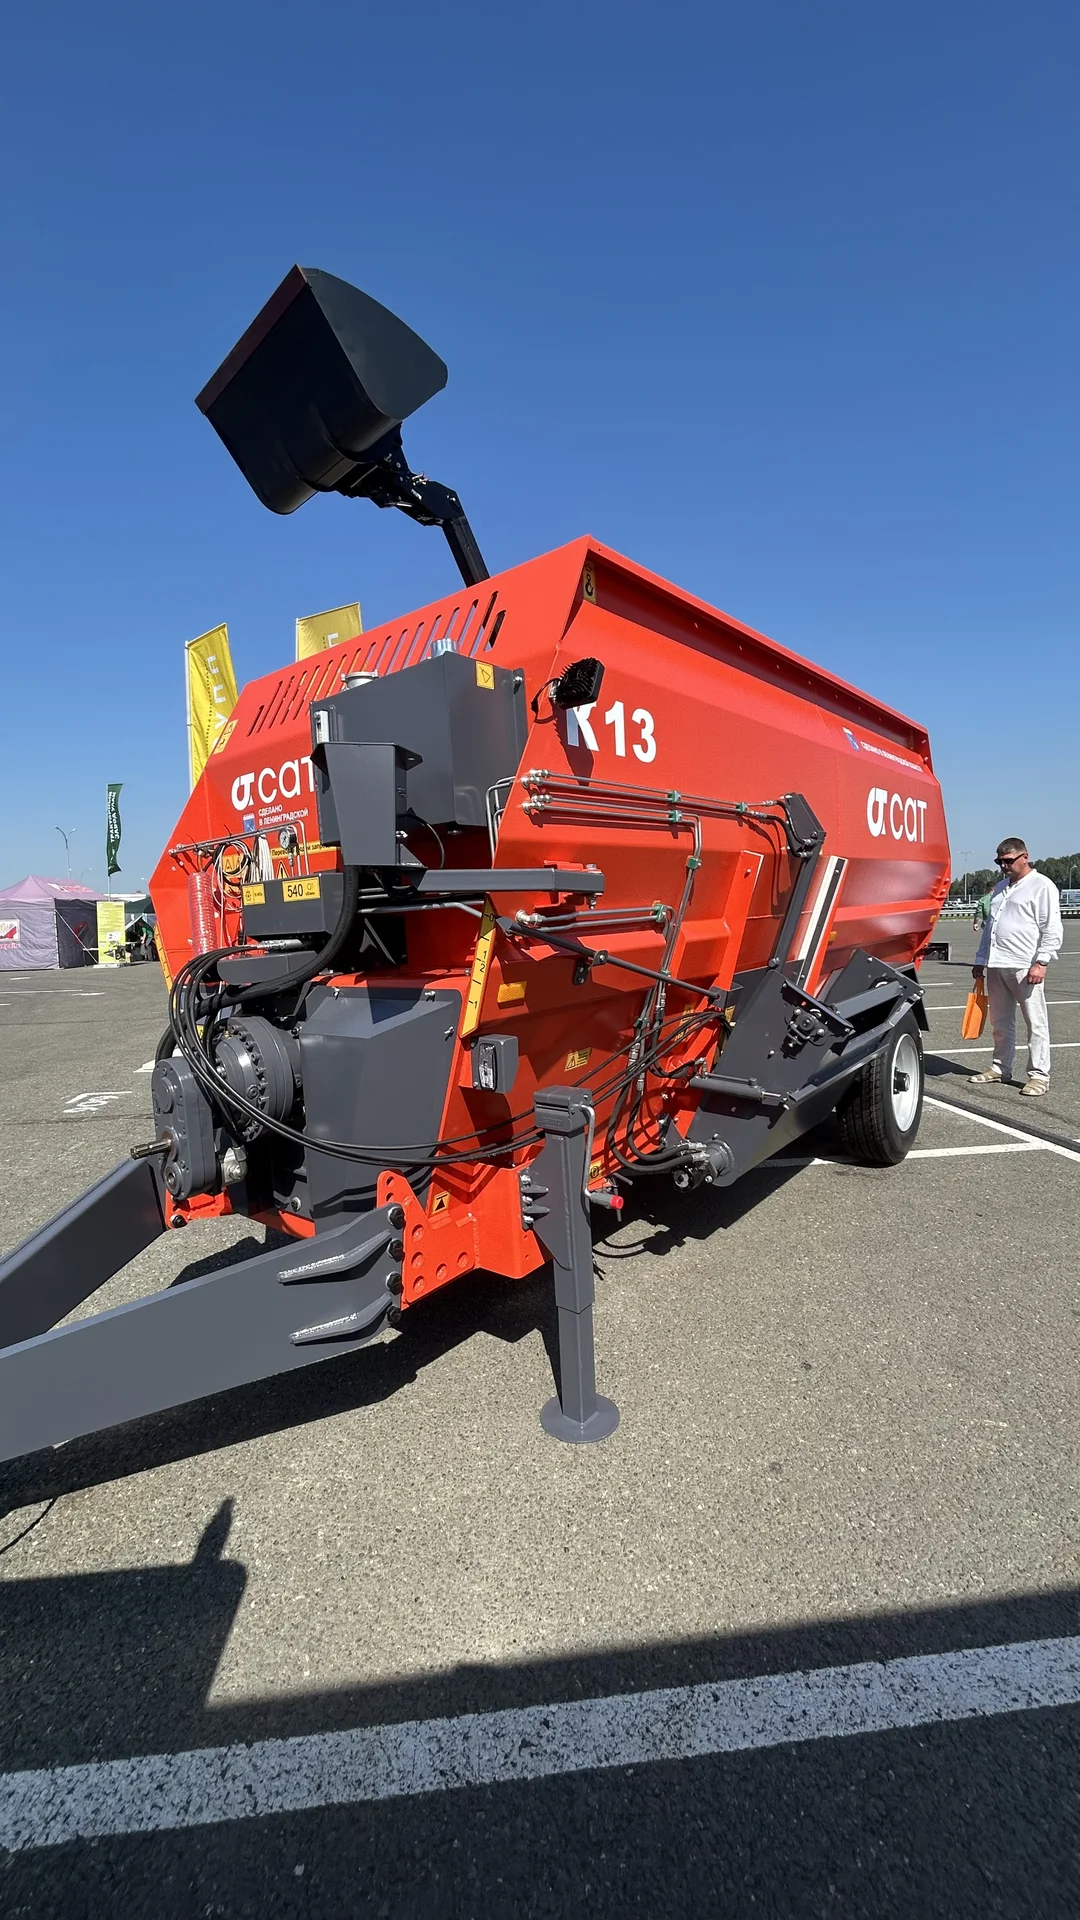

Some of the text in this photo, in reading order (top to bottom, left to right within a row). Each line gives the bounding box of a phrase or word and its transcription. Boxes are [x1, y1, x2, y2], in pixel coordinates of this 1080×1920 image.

[605, 700, 657, 763] 13
[258, 804, 283, 817] СДЕЛАНО
[259, 806, 309, 826] В ЛЕНИНГРАДСКОЙ
[287, 883, 304, 898] 540
